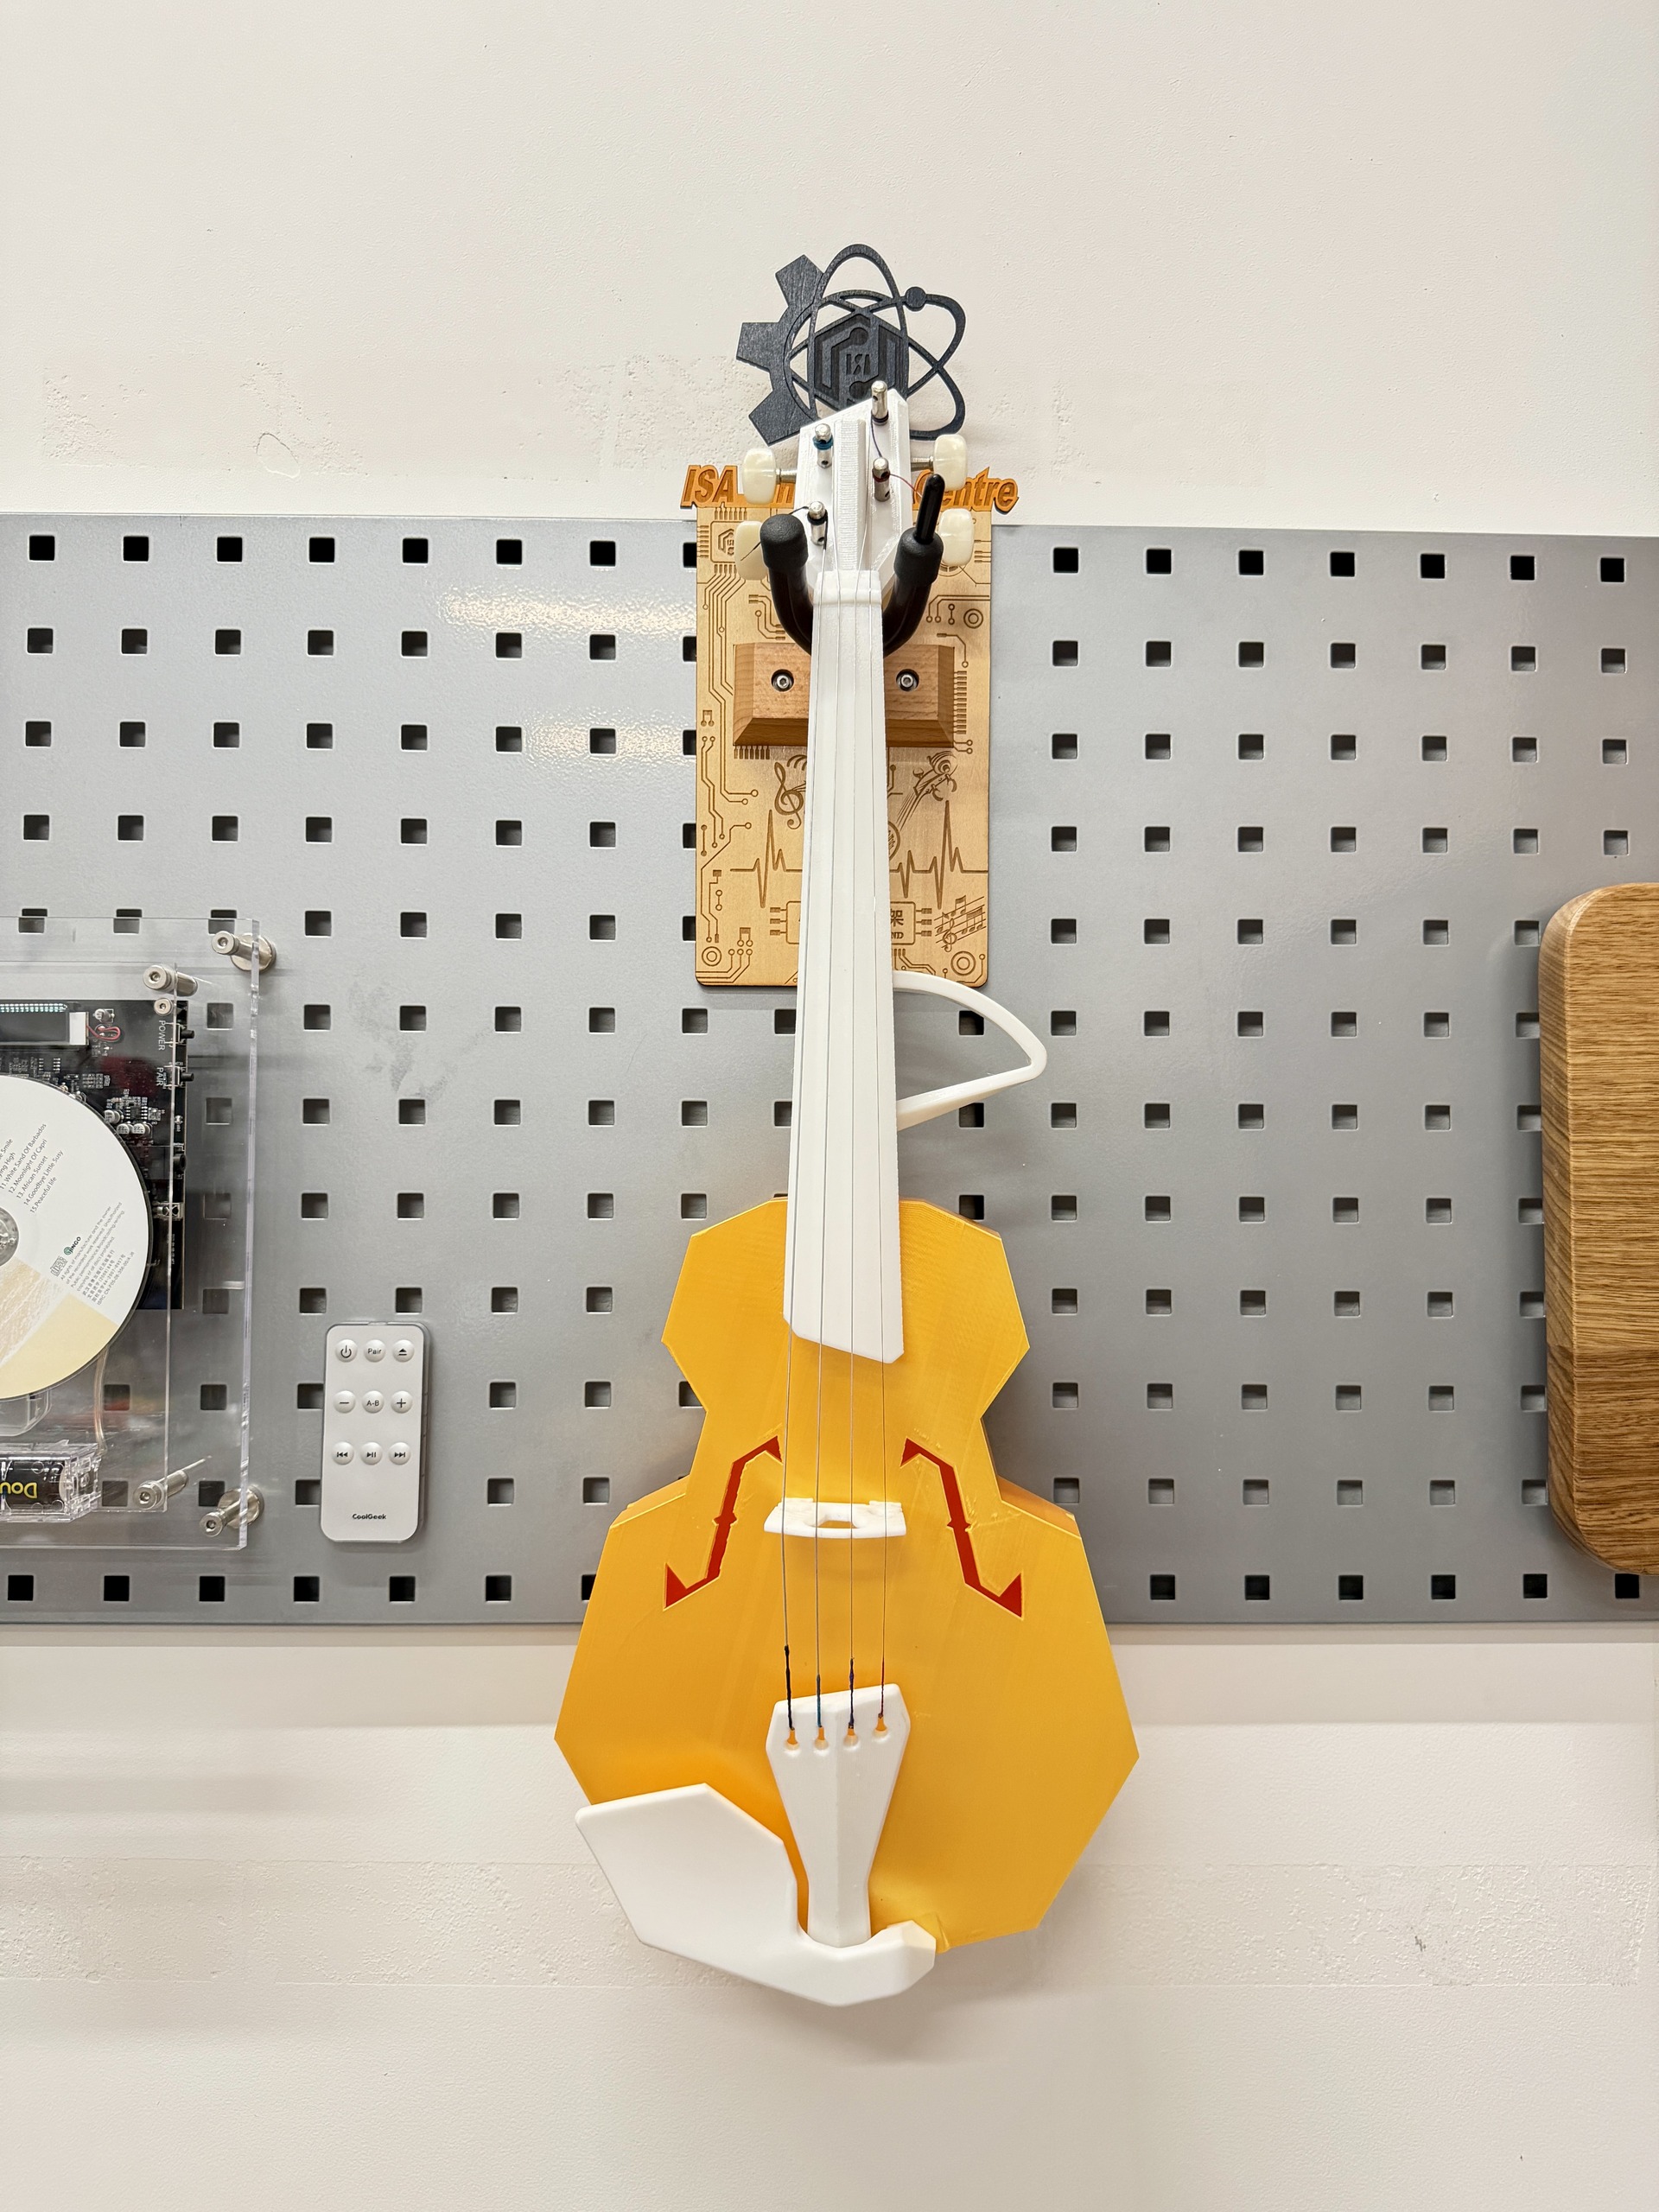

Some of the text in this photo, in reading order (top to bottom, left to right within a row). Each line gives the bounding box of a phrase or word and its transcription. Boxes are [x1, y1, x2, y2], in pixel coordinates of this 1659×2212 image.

[683, 468, 734, 503] ISA
[0, 1139, 12, 1153] Smile
[15, 1154, 25, 1166] Sand
[28, 1123, 46, 1146] Barbados
[35, 1139, 48, 1153] Capri
[4, 1152, 16, 1165] High
[34, 1155, 47, 1173] Sunset
[43, 1162, 54, 1175] Little
